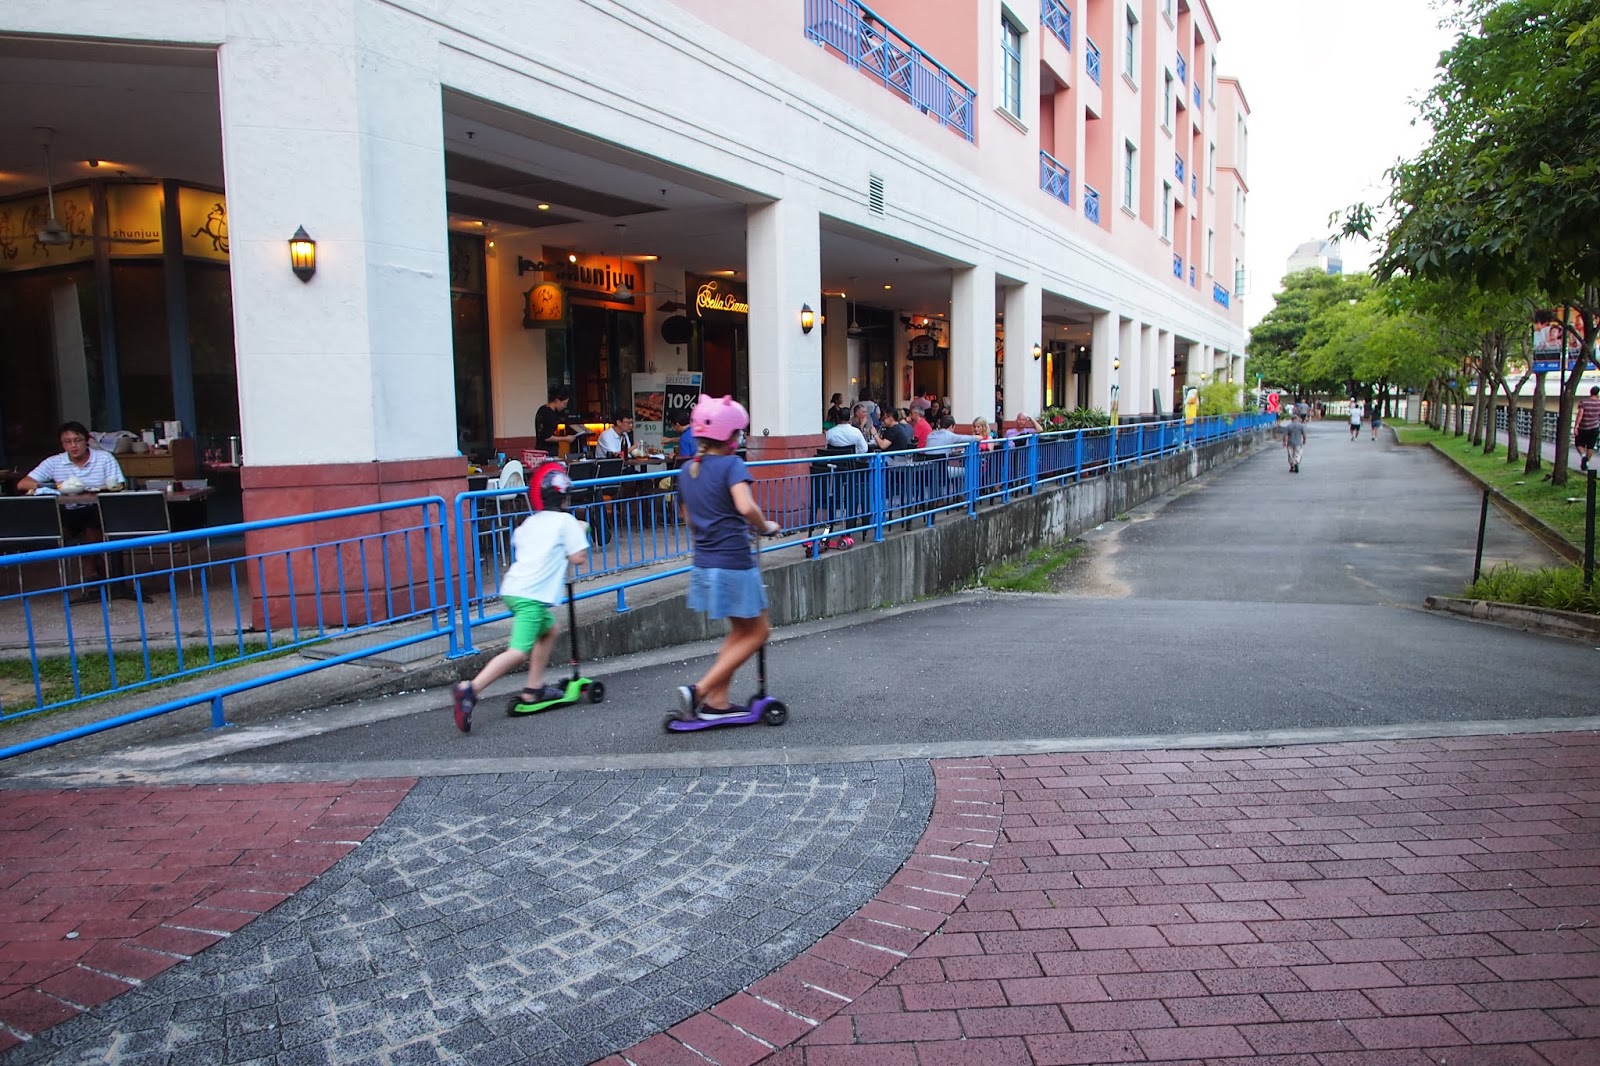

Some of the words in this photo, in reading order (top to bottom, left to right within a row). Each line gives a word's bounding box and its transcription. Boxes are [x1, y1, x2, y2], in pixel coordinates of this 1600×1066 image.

[113, 229, 159, 238] shunjuu
[696, 280, 724, 317] Bella
[665, 376, 690, 384] SELECTS
[667, 393, 697, 409] 10%
